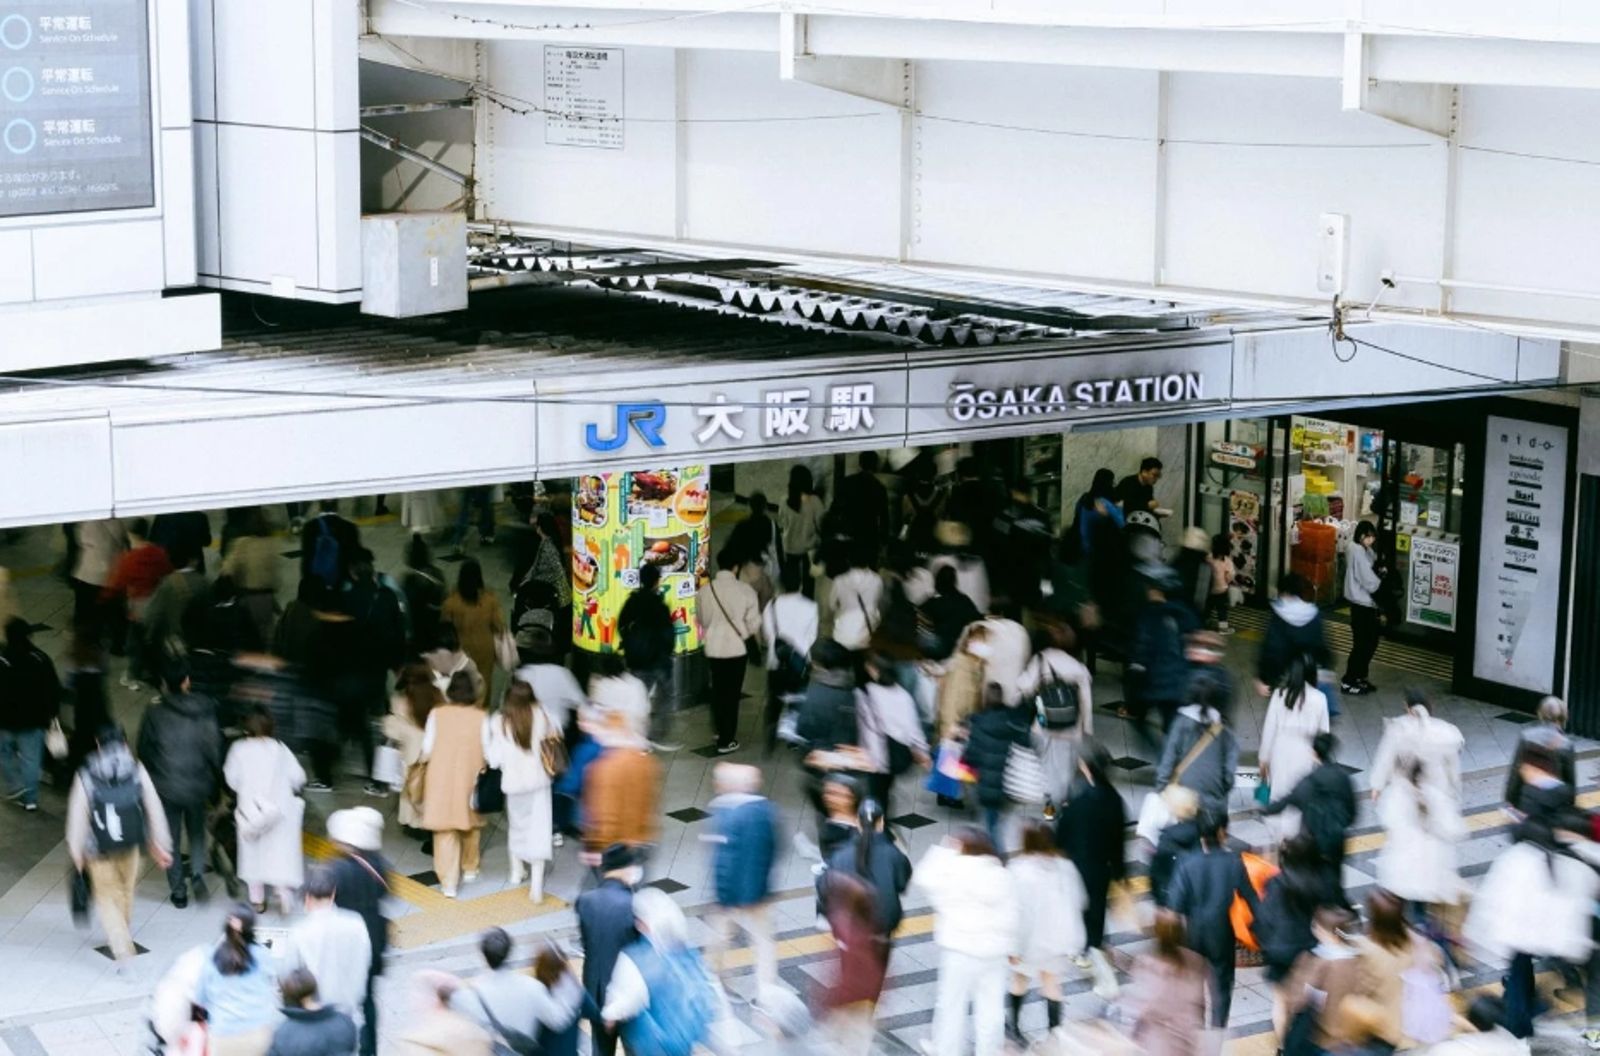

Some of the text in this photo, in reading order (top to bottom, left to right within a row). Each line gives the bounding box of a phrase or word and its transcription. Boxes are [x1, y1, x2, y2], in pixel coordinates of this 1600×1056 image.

[40, 16, 91, 31] 平常運転
[40, 35, 68, 44] Service
[82, 34, 118, 42] Schedule
[42, 68, 94, 82] 平常運転
[42, 85, 119, 95] Service On Schedule
[43, 119, 95, 134] 平常運転
[44, 136, 122, 146] Service On Schedule
[1075, 373, 1205, 411] STATION
[586, 383, 876, 451] JR 大阪駅
